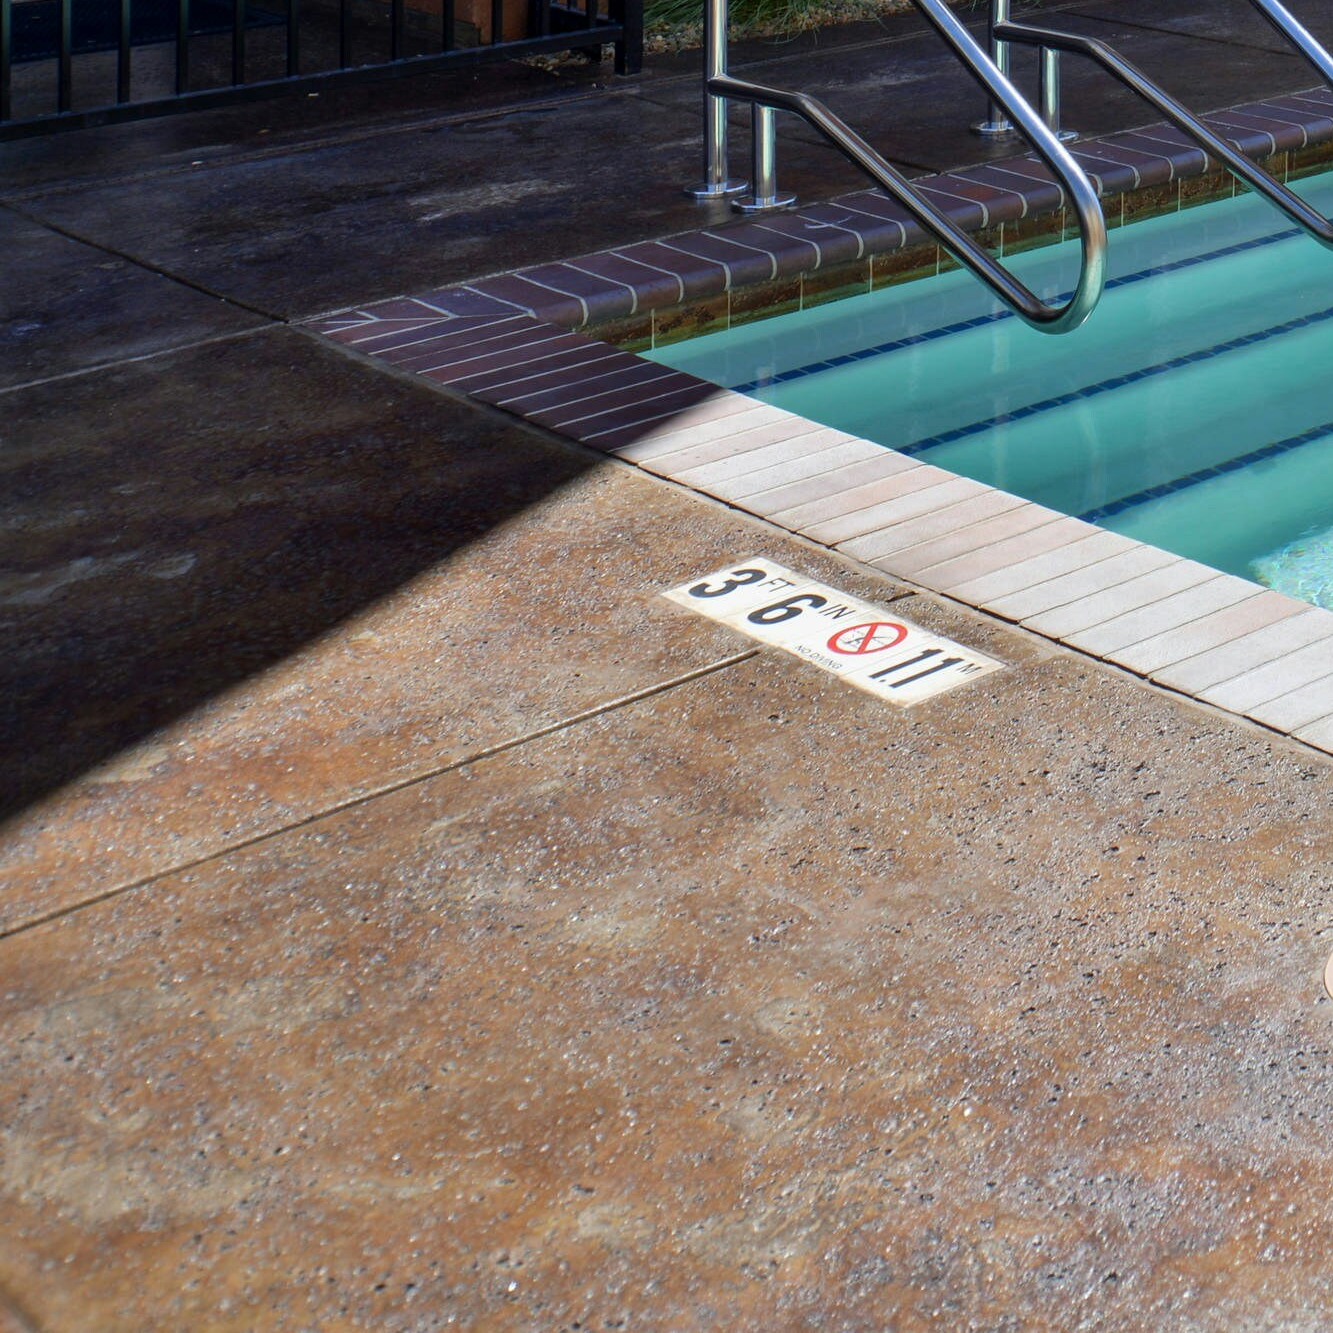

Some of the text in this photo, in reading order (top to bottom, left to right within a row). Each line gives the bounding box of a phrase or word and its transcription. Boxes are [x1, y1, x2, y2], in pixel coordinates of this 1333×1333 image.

[688, 569, 767, 599] 3
[760, 578, 796, 593] FT
[747, 594, 828, 625] 6
[818, 604, 856, 621] IN
[796, 644, 842, 670] NO DIVING
[960, 662, 982, 675] M
